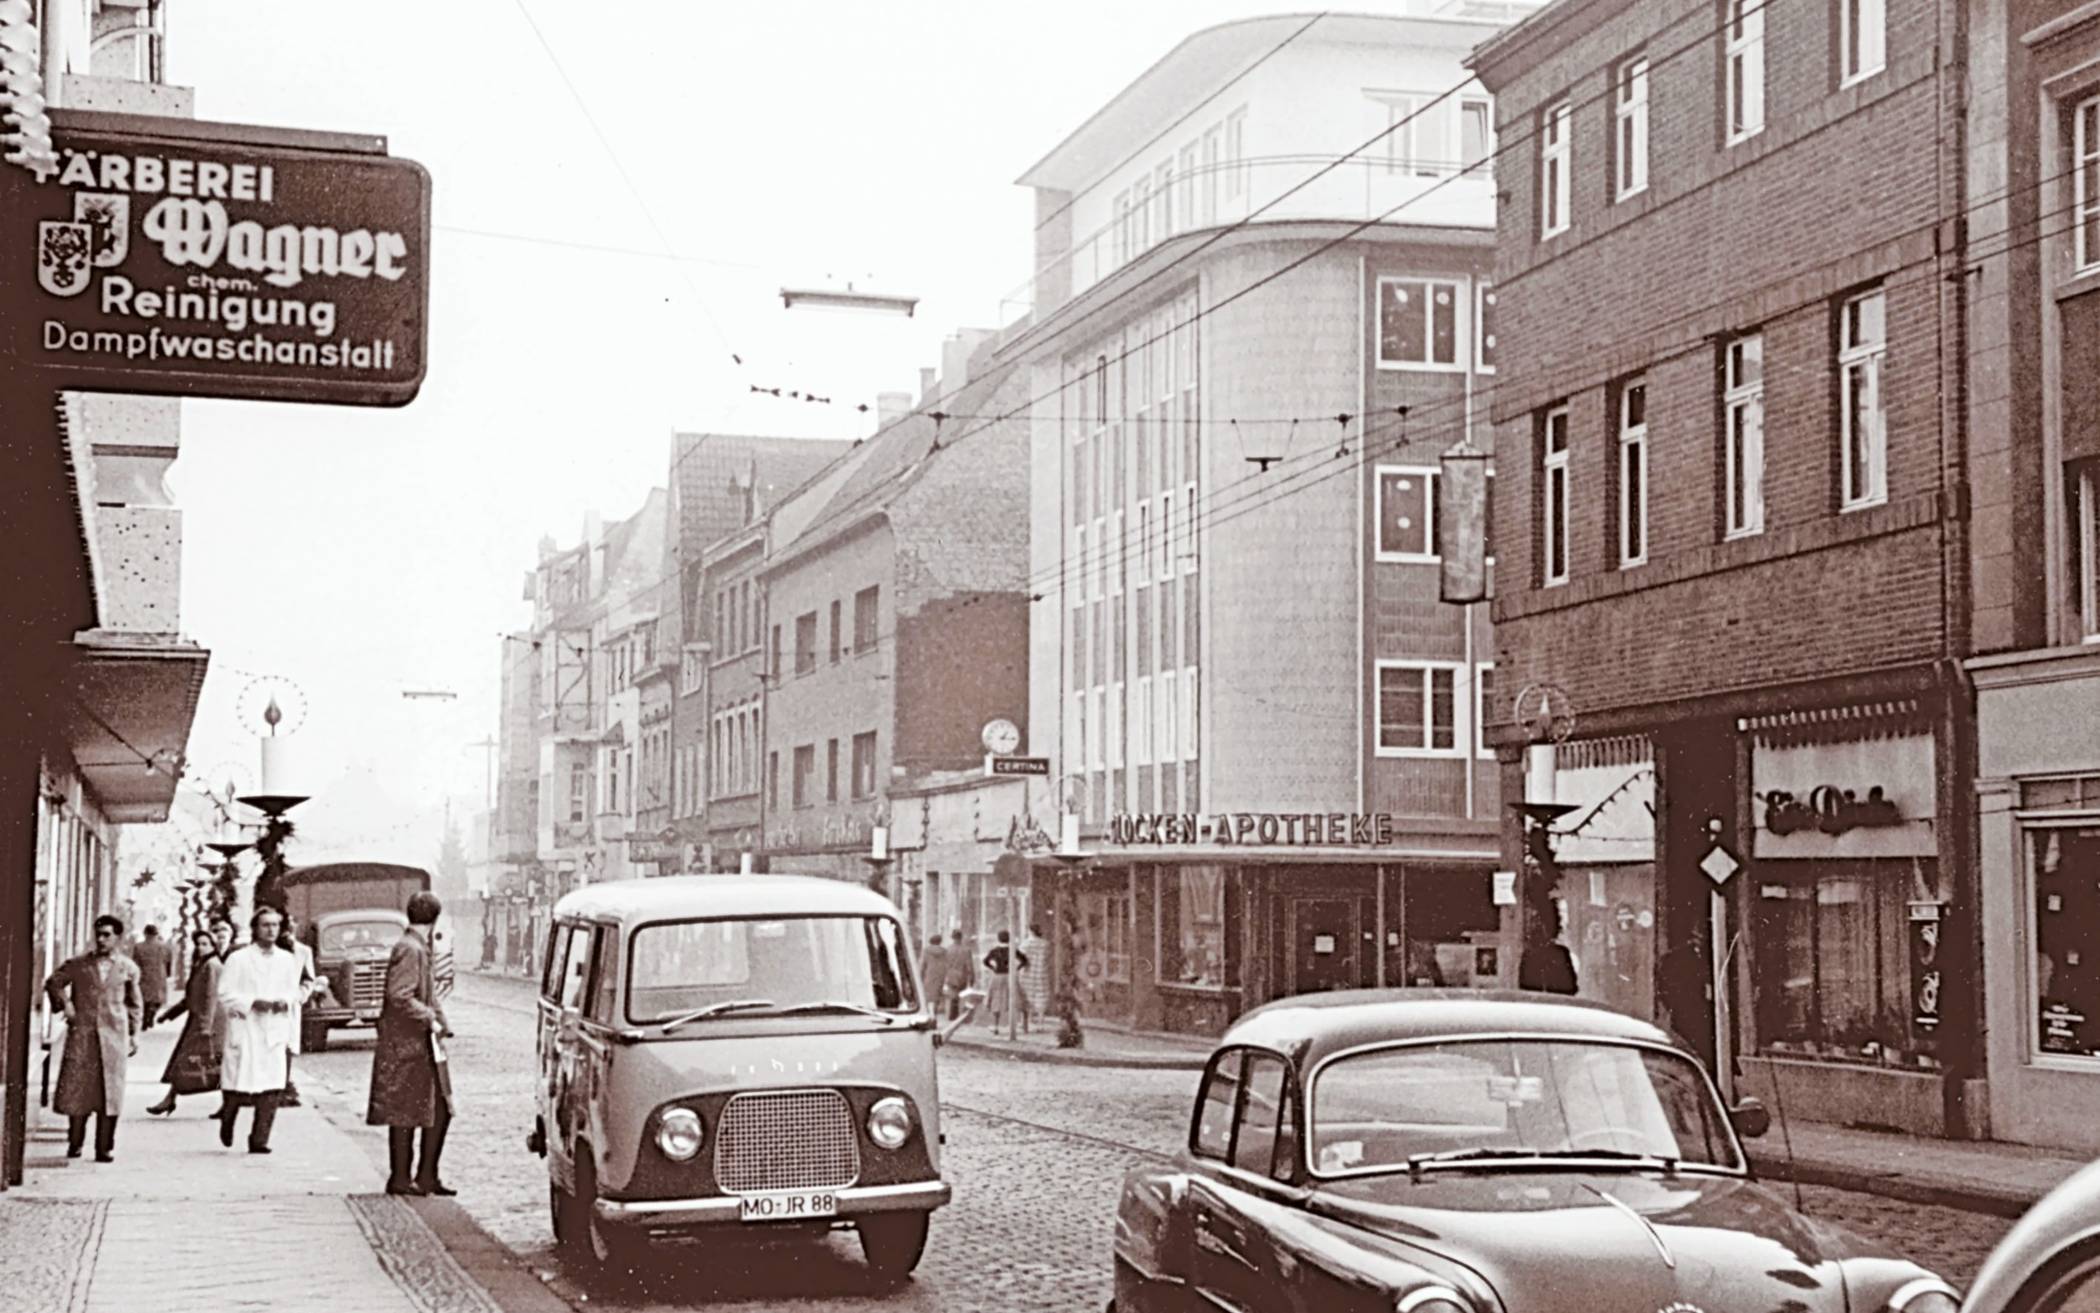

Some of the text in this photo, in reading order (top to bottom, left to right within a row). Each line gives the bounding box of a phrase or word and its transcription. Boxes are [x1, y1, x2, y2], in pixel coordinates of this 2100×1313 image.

[142, 197, 408, 287] Wagner
[187, 274, 259, 291] chem.
[101, 275, 337, 336] Reinigung
[43, 320, 395, 370] Dampfwaschanstalt
[996, 761, 1046, 772] CERTINA
[811, 1194, 833, 1212] 88
